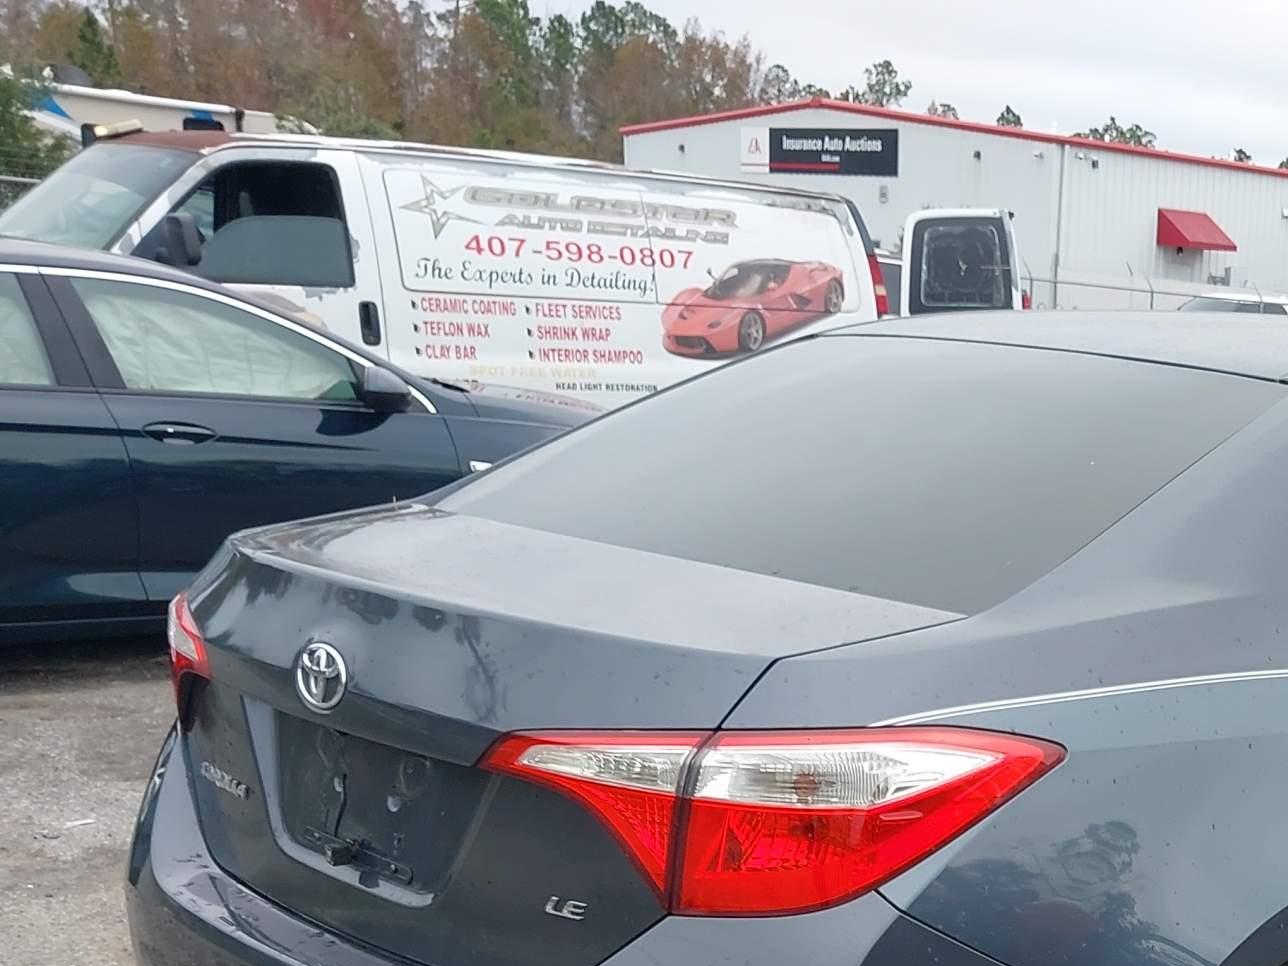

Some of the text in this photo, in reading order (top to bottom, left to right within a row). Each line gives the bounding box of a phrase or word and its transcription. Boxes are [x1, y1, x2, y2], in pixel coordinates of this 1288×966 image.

[782, 135, 883, 152] Insurance Auto Auctions
[494, 213, 583, 232] AUTO
[464, 234, 694, 270] 407-598-0807
[415, 257, 656, 297] The Experts in Detailing!
[420, 297, 517, 316] CERAMIC COATING
[535, 302, 622, 320] FLEET SERVICES
[424, 321, 490, 338] TEFLON WAX
[537, 325, 611, 341] SHRINK WRAP
[425, 344, 477, 360] CLAY BAR
[539, 347, 643, 364] INTERIOR SHAMPOO
[555, 382, 658, 393] HEAD LIGHT RESTORATION
[545, 895, 588, 920] LE
